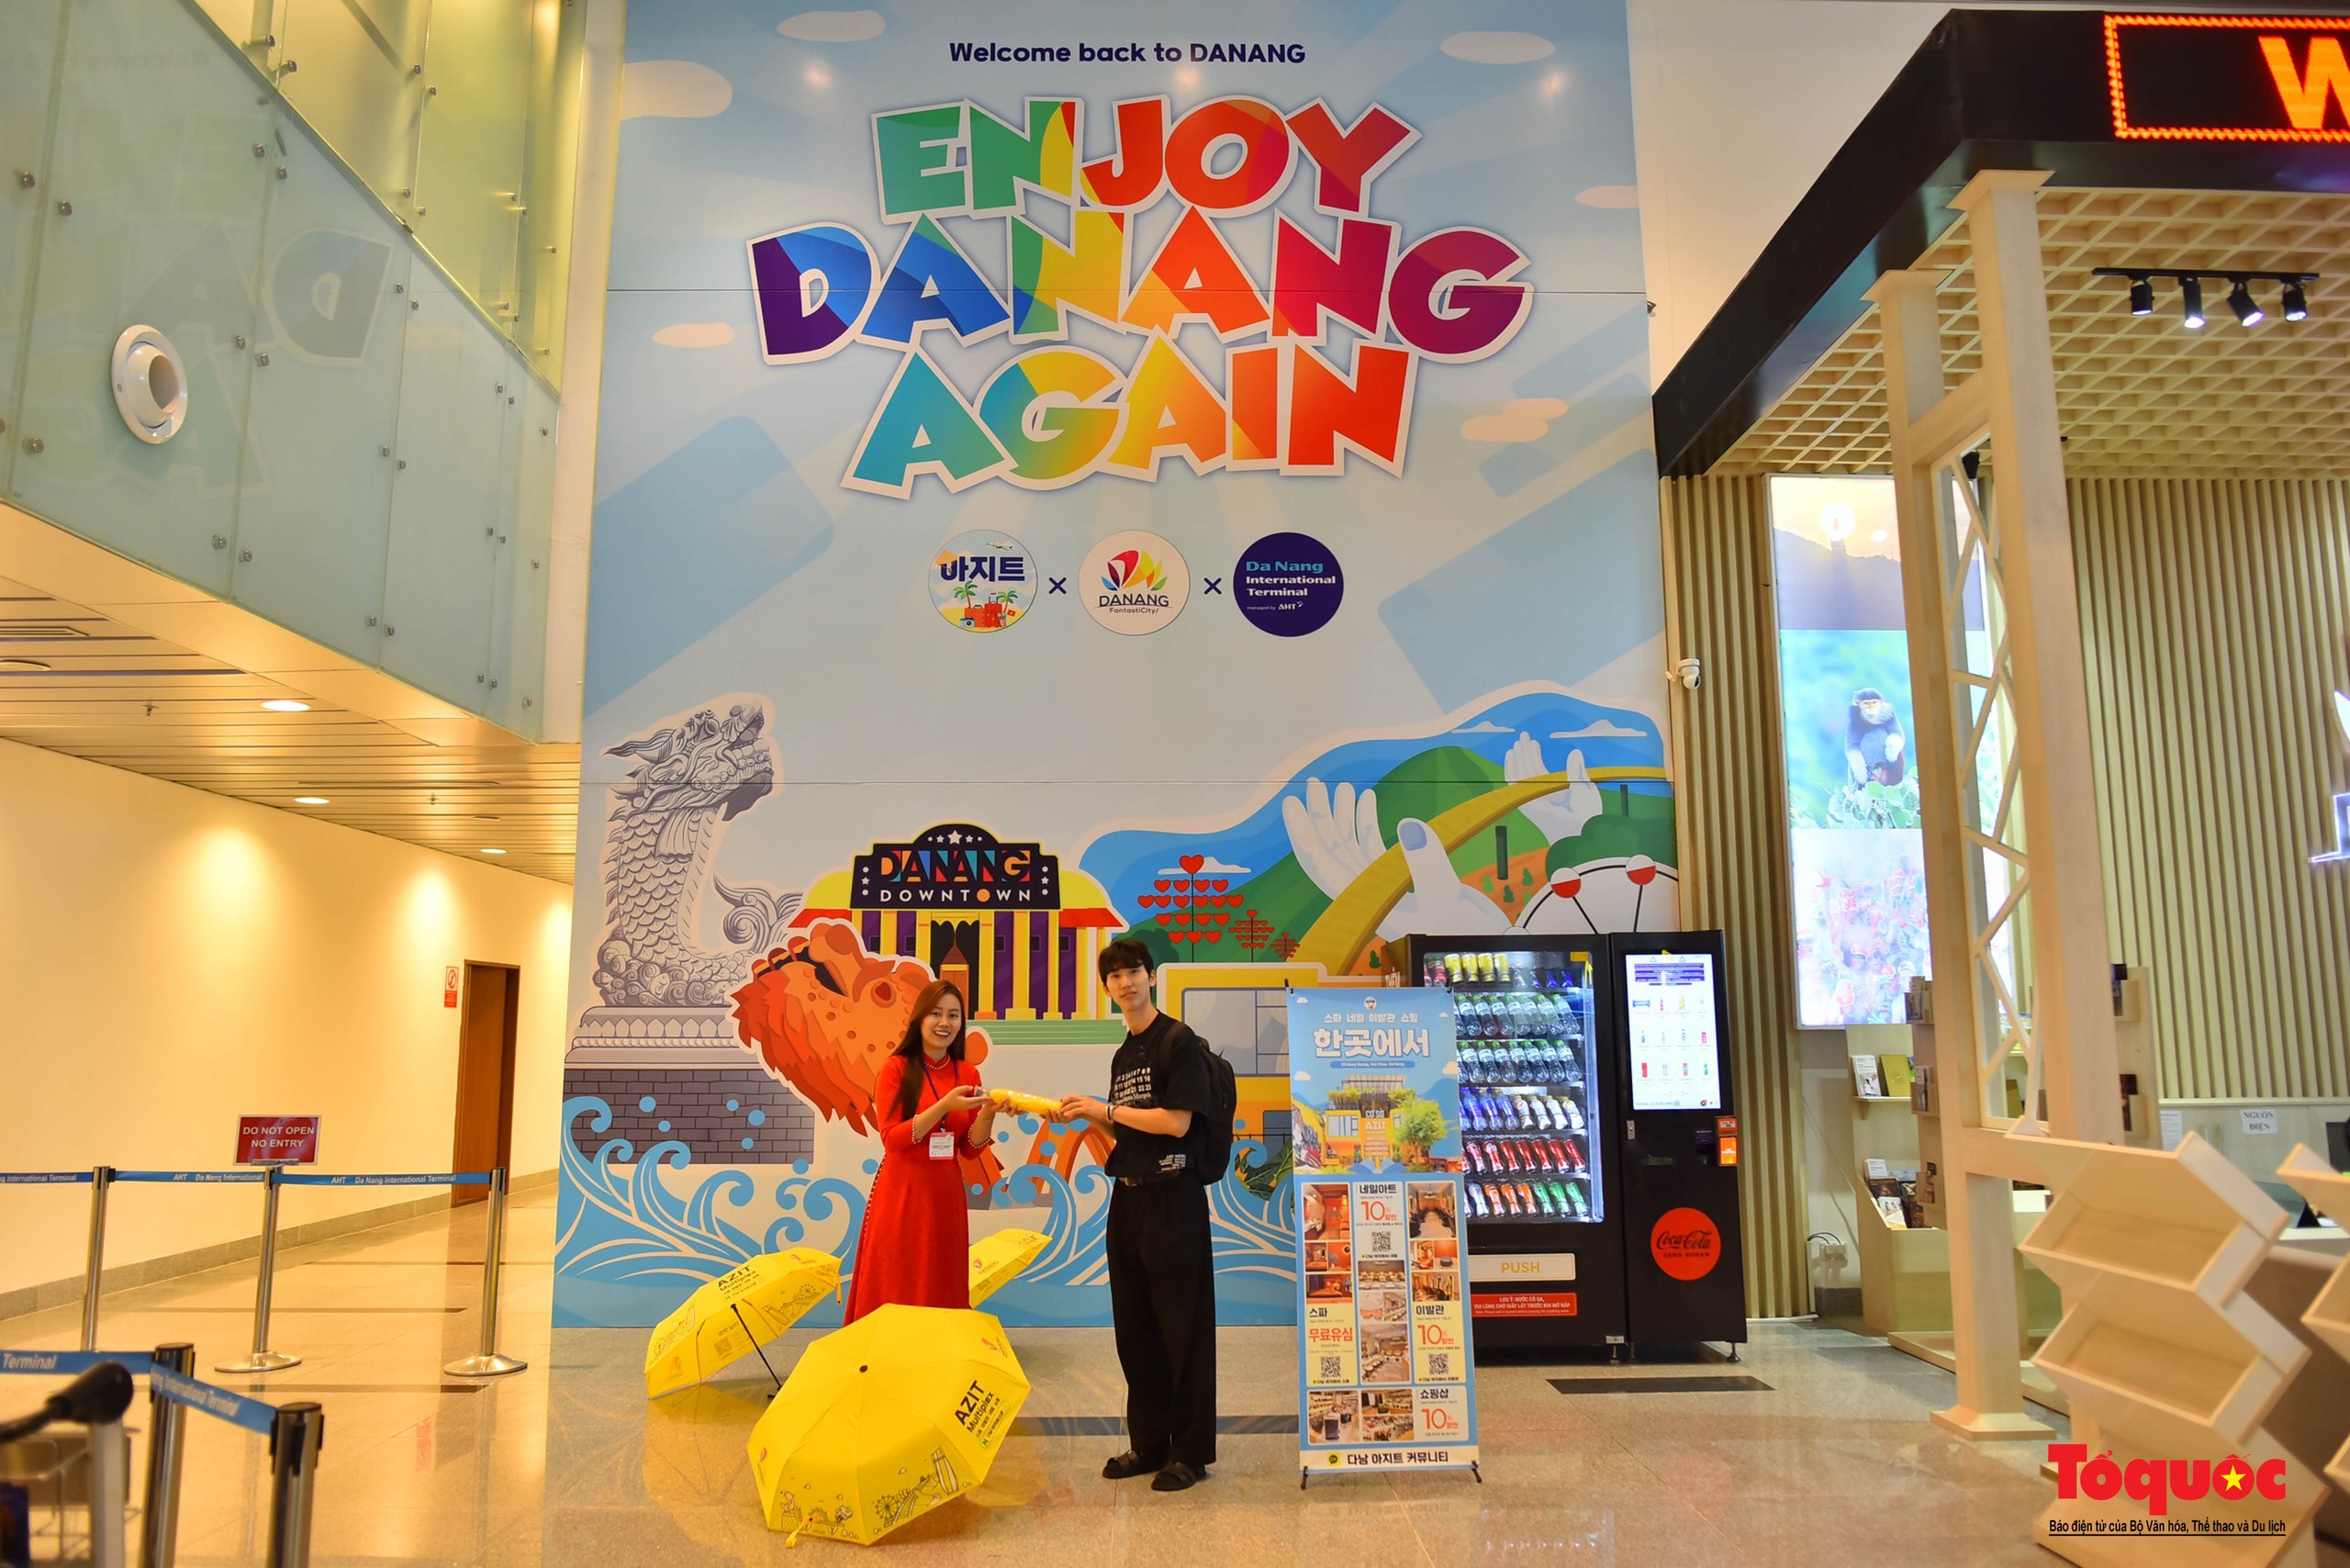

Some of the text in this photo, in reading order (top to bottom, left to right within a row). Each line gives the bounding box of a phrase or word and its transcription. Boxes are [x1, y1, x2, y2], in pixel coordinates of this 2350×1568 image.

[948, 42, 1306, 64] Welcome back to DANANG
[873, 96, 1416, 222] ENJOY
[748, 203, 1528, 360] DANANG
[846, 334, 1414, 494] AGAIN
[1246, 561, 1324, 574] Da Nang
[1246, 576, 1337, 584] International
[1247, 588, 1308, 596] Terminal
[1099, 594, 1169, 607] DANANG
[879, 849, 1031, 882] DANANG
[879, 888, 1031, 902] DOWNTOWN
[1324, 1013, 1418, 1023] 스파 네일 이발관 쇼핑
[1314, 1028, 1430, 1058] 한곳에서
[243, 1126, 314, 1135] DO NOT OPEN
[252, 1139, 304, 1148] NO ENTRY
[206, 1174, 222, 1182] Nang
[223, 1173, 263, 1182] International
[365, 1177, 383, 1185] Nang
[385, 1176, 426, 1184] International
[428, 1174, 456, 1182] Terminal
[1360, 1184, 1397, 1193] 네일아트
[1360, 1201, 1385, 1221] 10
[1657, 1230, 1712, 1249] Coca-Cola
[1501, 1262, 1540, 1273] PUSH
[718, 1264, 751, 1288] AZIT
[720, 1271, 756, 1292] Multiplex
[1309, 1307, 1327, 1317] 스파
[1416, 1305, 1444, 1315] 이발관
[1309, 1327, 1353, 1342] 무료유심
[1417, 1325, 1442, 1345] 10
[3, 1353, 58, 1370] Terminal
[1420, 1389, 1449, 1399] 쇼핑샵
[955, 1380, 984, 1426] AZIT
[967, 1392, 994, 1433] Multiplex
[1421, 1408, 1447, 1429] 10
[1347, 1451, 1449, 1465] 다낭 아지트 커뮤니티
